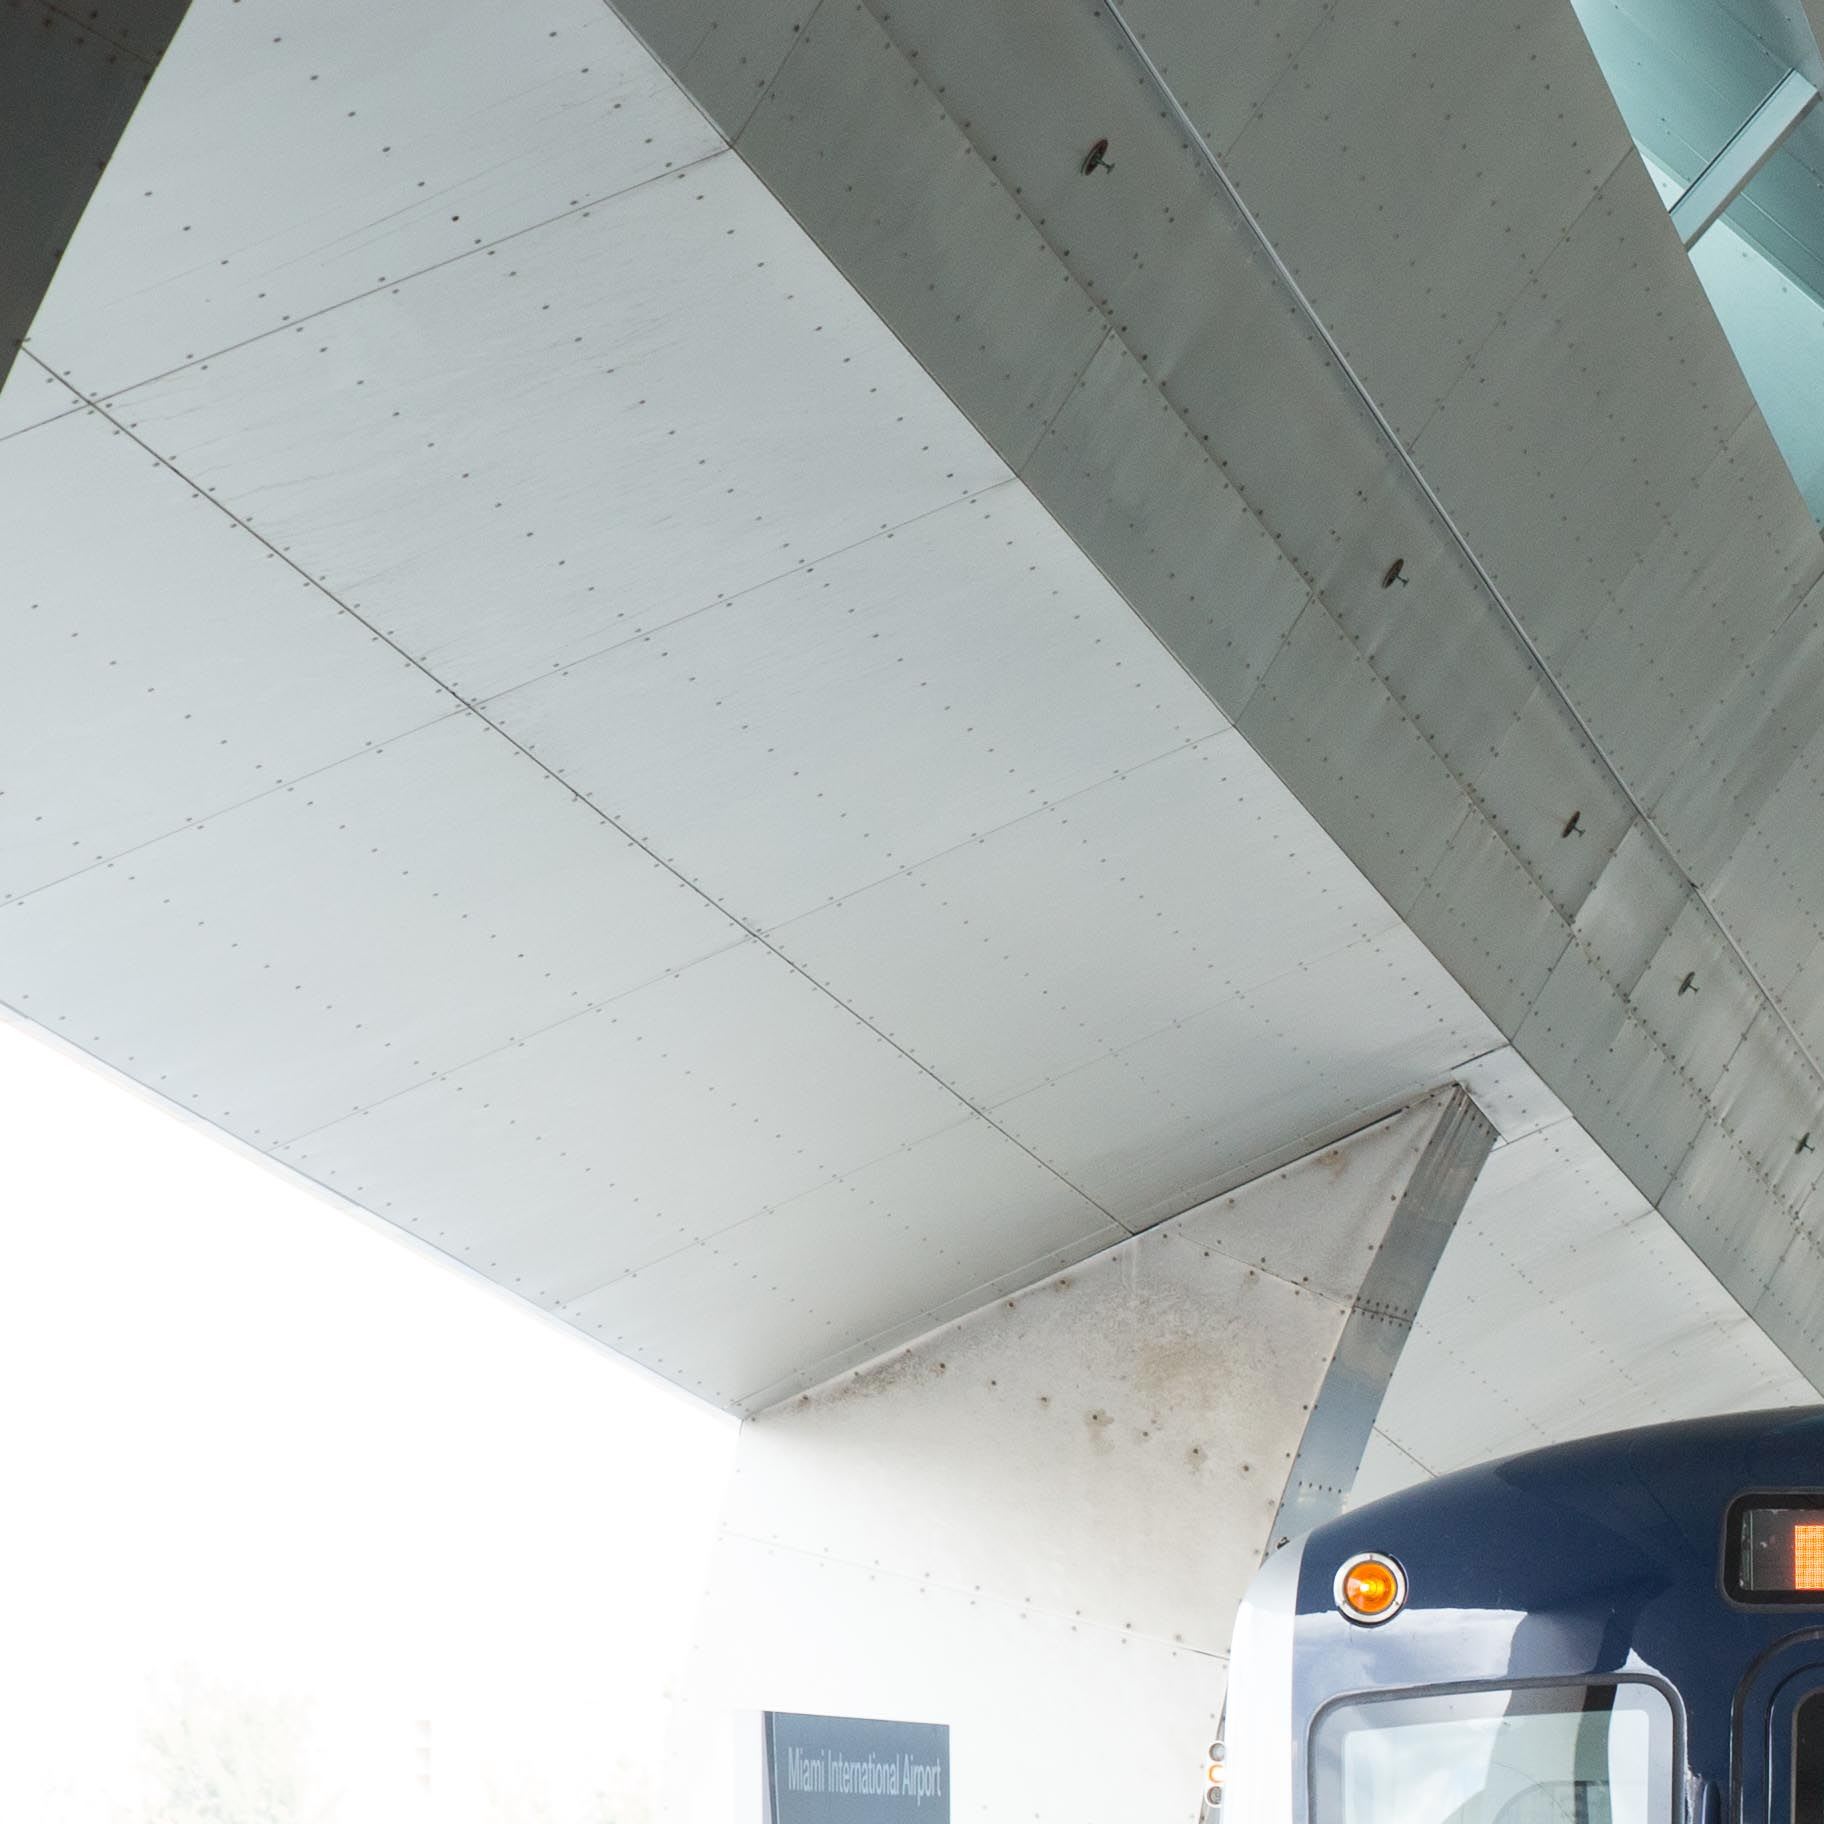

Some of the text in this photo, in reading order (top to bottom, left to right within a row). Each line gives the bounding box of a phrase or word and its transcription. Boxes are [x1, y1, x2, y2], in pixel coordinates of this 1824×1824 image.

[788, 1746, 942, 1806] Miami International Airport
